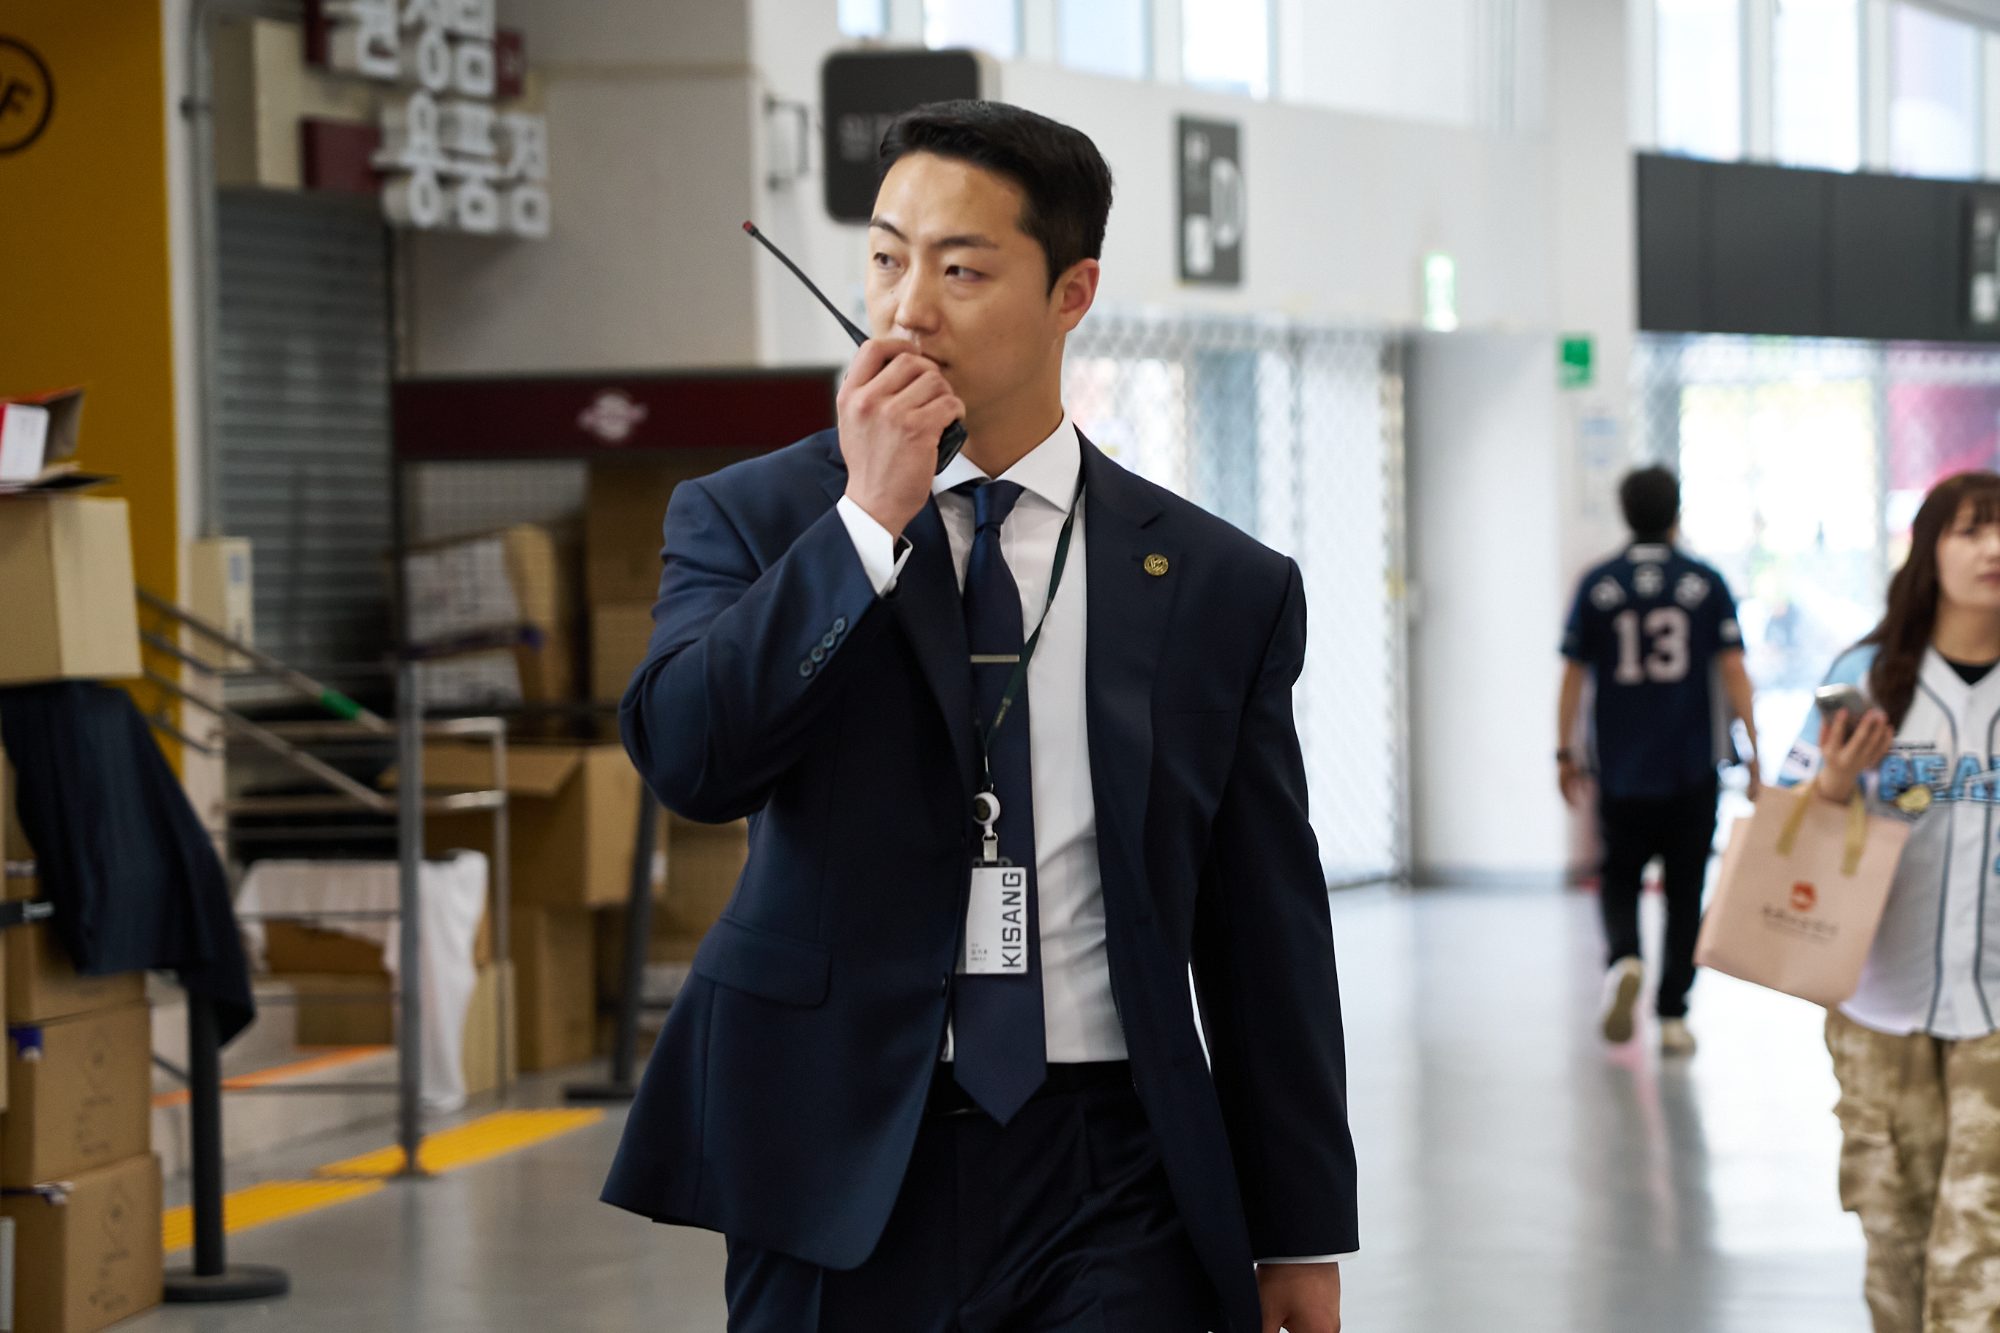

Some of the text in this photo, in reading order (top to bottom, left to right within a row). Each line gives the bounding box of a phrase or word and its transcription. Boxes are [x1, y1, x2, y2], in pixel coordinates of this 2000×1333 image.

[1613, 606, 1690, 685] 13
[1878, 752, 2000, 801] BEA
[1002, 872, 1021, 968] KISANG
